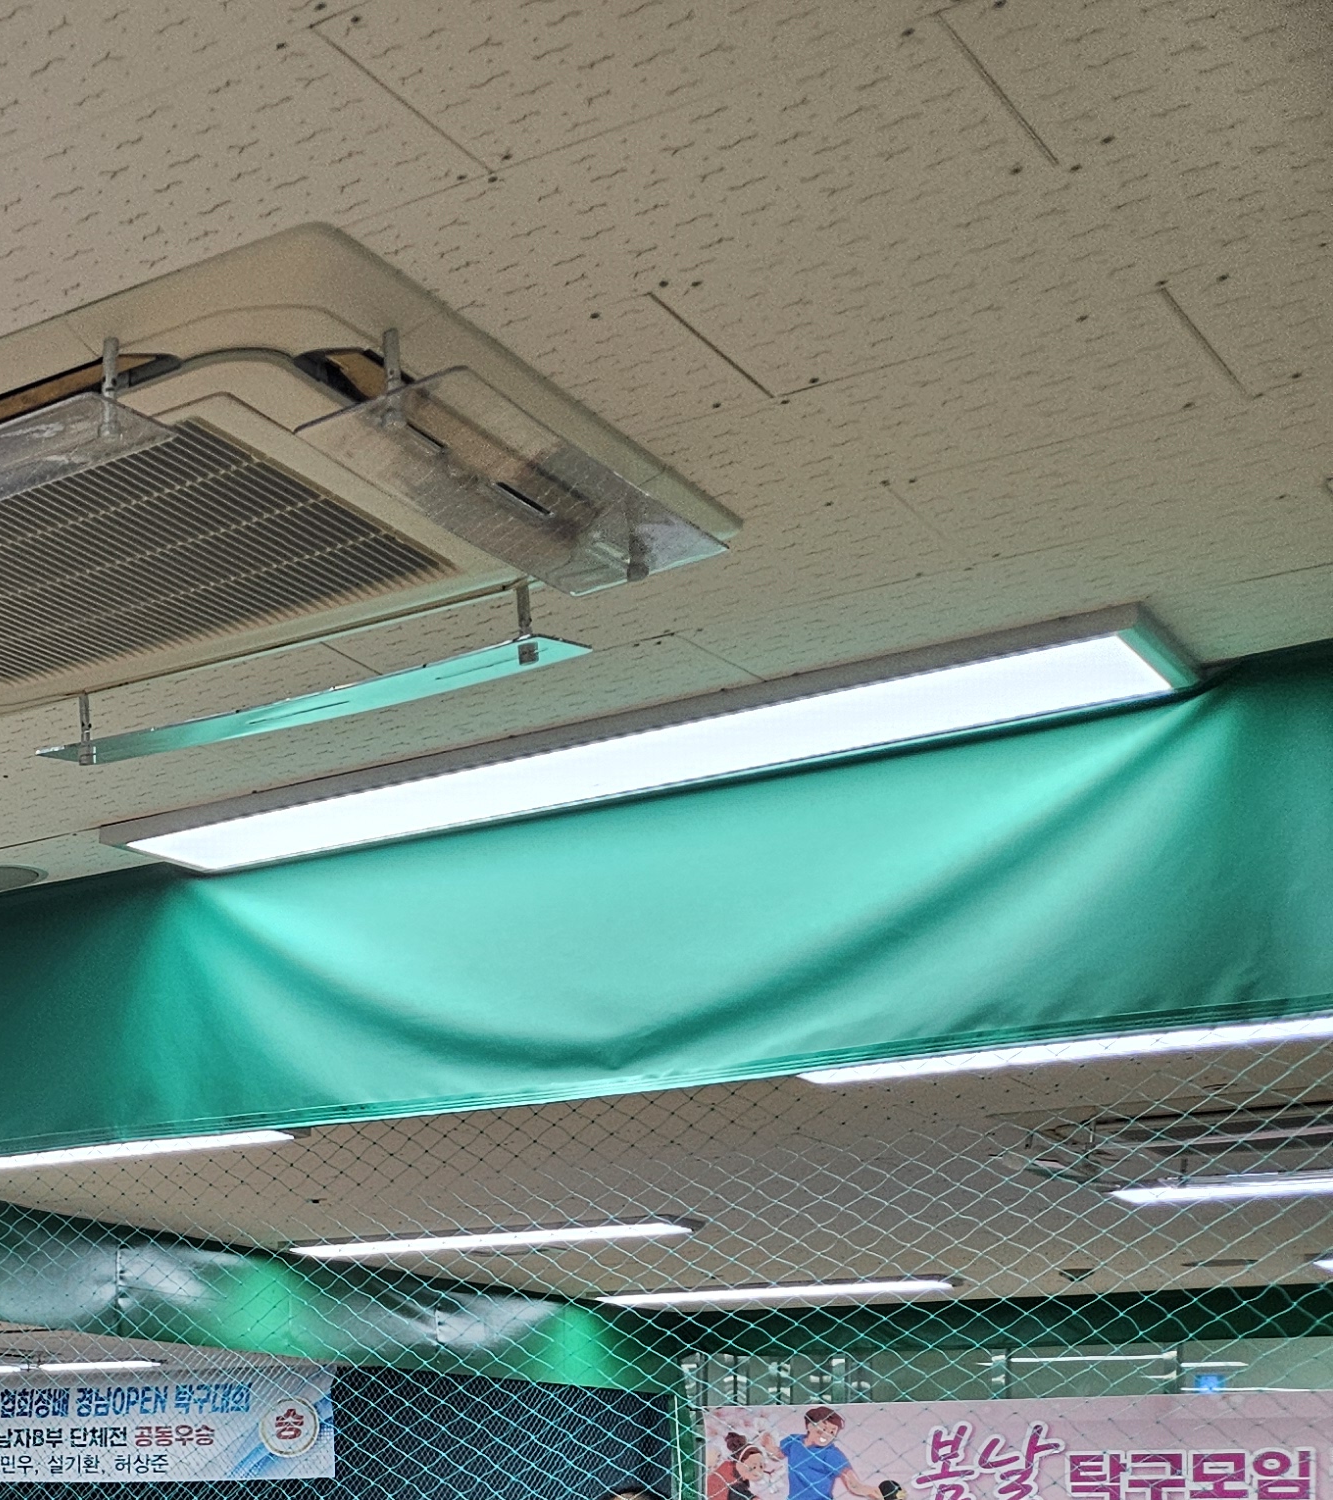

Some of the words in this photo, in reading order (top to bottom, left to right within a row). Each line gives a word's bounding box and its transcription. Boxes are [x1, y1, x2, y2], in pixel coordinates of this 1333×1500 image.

[76, 1384, 168, 1417] 경남OPEN
[174, 1382, 252, 1414] 탁구대회
[70, 1426, 127, 1448] 단체전
[134, 1424, 215, 1447] 공동우승
[275, 1408, 304, 1440] 승
[47, 1454, 105, 1475] 설기환,
[114, 1453, 169, 1474] 허상준
